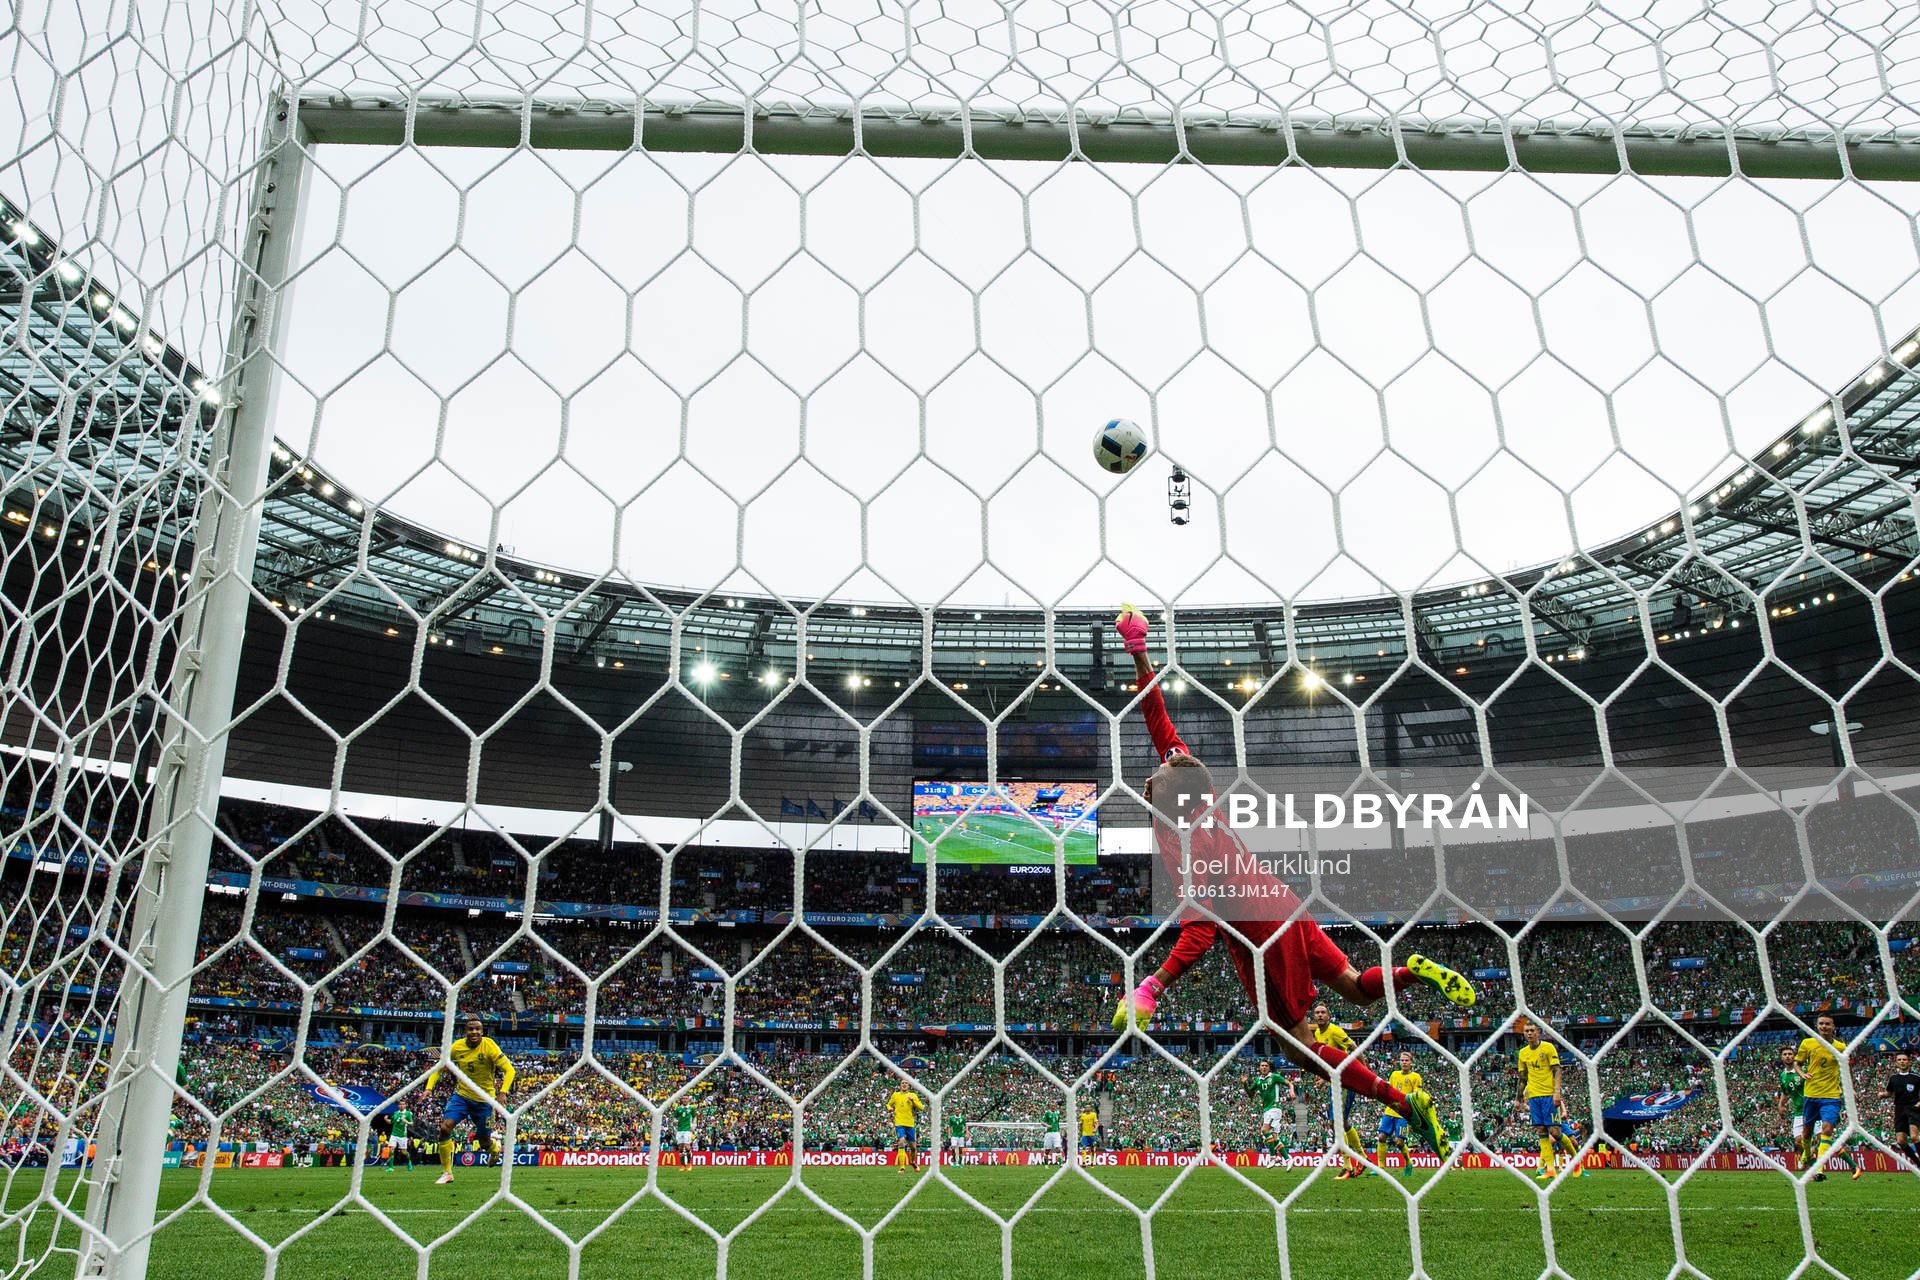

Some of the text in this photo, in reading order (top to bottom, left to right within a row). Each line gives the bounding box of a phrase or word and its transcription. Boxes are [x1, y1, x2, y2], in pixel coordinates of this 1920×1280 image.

[1009, 866, 1051, 874] EURO2016
[1884, 872, 1906, 881] UEFA
[443, 897, 463, 905] UEFA
[638, 909, 680, 918] SAINT-NIS
[467, 1062, 476, 1073] 5
[1820, 1058, 1828, 1068] 2
[1551, 1111, 1562, 1124] 14
[479, 1153, 535, 1165] RSECT
[561, 1152, 651, 1166] McDonald's
[711, 1152, 751, 1165] lovin'
[756, 1152, 767, 1165] it
[800, 1152, 887, 1166] McDonald's
[988, 1152, 998, 1166] it
[1146, 1152, 1169, 1166] i'm
